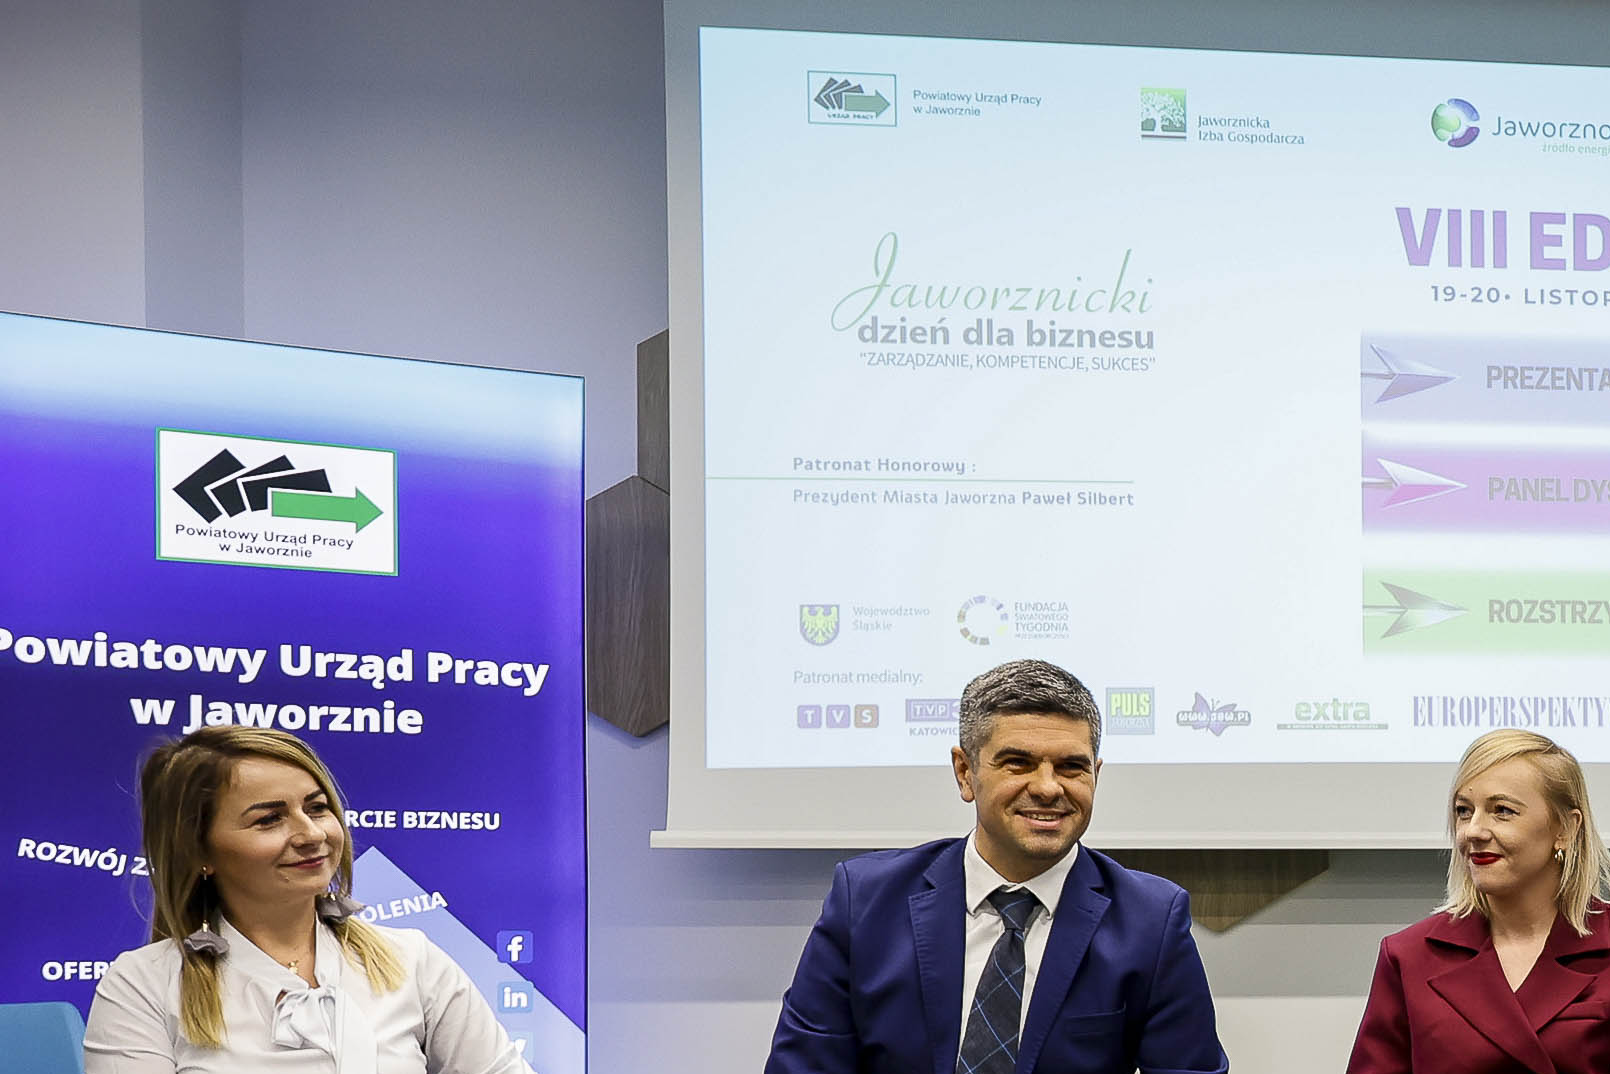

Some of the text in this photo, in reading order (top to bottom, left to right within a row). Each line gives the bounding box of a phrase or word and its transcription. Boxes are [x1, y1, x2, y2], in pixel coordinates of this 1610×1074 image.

[913, 89, 1042, 107] Powiatowy Urząd Pracy
[925, 105, 981, 117] Jaworznie
[1198, 115, 1270, 129] Jaworznicka
[1199, 130, 1305, 145] Izba Gospodarcza
[1395, 207, 1508, 269] VIII
[831, 231, 1153, 332] Jaworznicki
[857, 315, 1154, 350] dzień dla biznesu
[976, 354, 1089, 372] KOMPETENCJE,
[793, 458, 872, 472] Patronat
[877, 458, 966, 475] Honorowy
[793, 489, 1134, 507] Prezydent Miasta Jaworzna Paweł Silbert
[1488, 476, 1569, 502] PANEL
[175, 524, 354, 550] Powiatowy Urząd Pracy
[219, 542, 313, 558] w Jaworznie
[1014, 602, 1069, 613] FUNDACJA
[1014, 622, 1069, 633] TYGODNIA
[279, 643, 414, 689] Urząd
[427, 651, 550, 697] Pracy
[793, 670, 923, 689] Patronat medialny:
[129, 694, 424, 735] w Jaworznie
[1110, 692, 1151, 717] PULS
[1295, 697, 1371, 721] extra
[909, 727, 958, 737] KATOWIC
[344, 810, 501, 831] RCIE BIZNESU
[17, 838, 128, 877] ROZWÓJ
[357, 891, 449, 923] OLENIA
[42, 960, 115, 981] OFER
